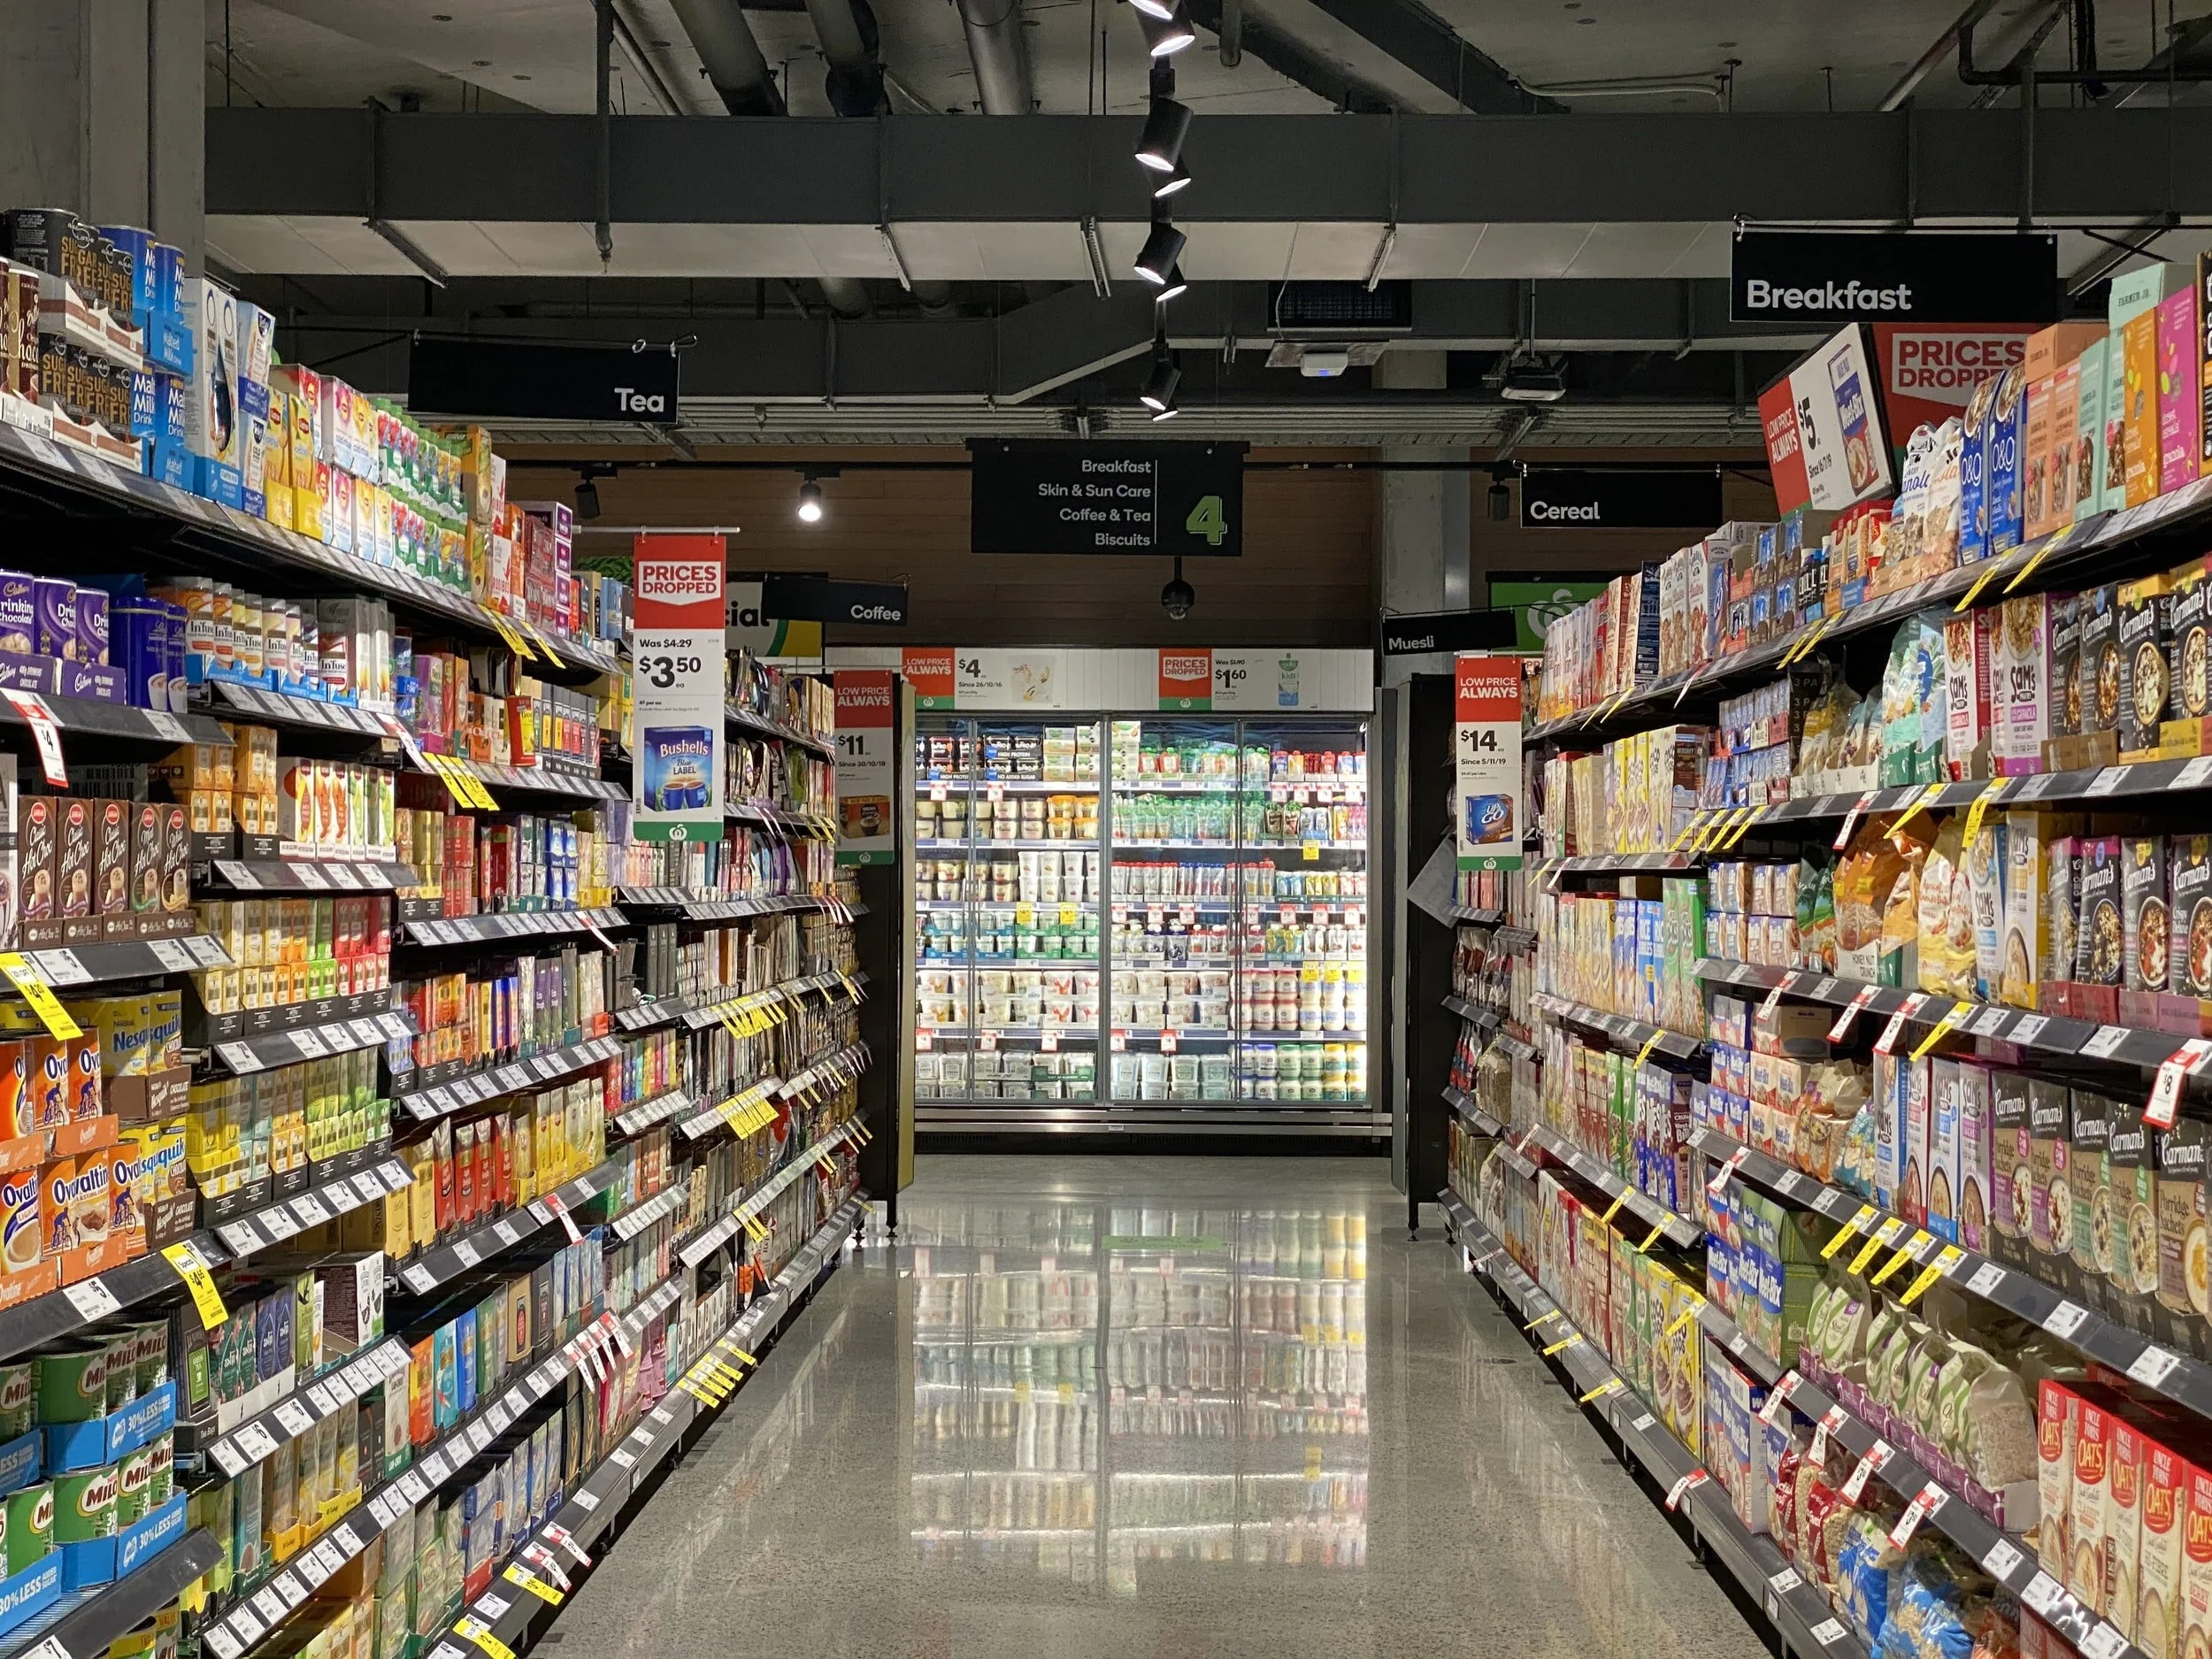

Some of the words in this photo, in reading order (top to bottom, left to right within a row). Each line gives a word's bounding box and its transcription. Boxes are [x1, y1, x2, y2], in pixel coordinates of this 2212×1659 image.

[1747, 280, 1912, 311] Breakfast
[1899, 340, 2025, 366] PRICES
[1898, 368, 2005, 388] DROPP
[614, 388, 664, 412] Tea
[134, 412, 153, 426] Drink
[1778, 408, 1794, 431] PRICE
[1771, 429, 1799, 464] ALWAYS
[1081, 459, 1151, 473] Breakfast
[1038, 483, 1068, 496] Skin
[1071, 484, 1082, 496] &
[1086, 484, 1113, 497] Sun
[1117, 485, 1151, 497] Care
[1059, 508, 1106, 521] Coffee
[1109, 508, 1120, 521] &
[1123, 509, 1151, 521] Tea
[1186, 495, 1227, 545] 4
[1530, 501, 1601, 520] Cereal
[1094, 533, 1151, 546] Biscuits
[642, 565, 717, 581] PRICES
[642, 581, 718, 594] DROPPED
[850, 604, 902, 620] Coffee
[2170, 581, 2205, 629] Carman's
[2082, 604, 2113, 642] Carman's
[2119, 600, 2154, 643] Carman's
[640, 639, 662, 648] Was
[664, 639, 692, 648] $4.29
[1388, 635, 1434, 650] Muesli
[906, 665, 952, 675] ALWAYS
[958, 658, 981, 678] $4
[1164, 658, 1206, 668] PRICES
[74, 672, 92, 693] Cadbury
[838, 687, 859, 695] LOW
[861, 686, 890, 695] PRICE
[1460, 678, 1484, 687] LOW
[1486, 677, 1517, 686] PRICE
[1460, 687, 1518, 699] ALWAYS
[838, 696, 890, 707] ALWAYS
[659, 740, 709, 758] Bushells
[1461, 730, 1497, 751] $14
[673, 766, 696, 775] LABEL
[1481, 809, 1504, 825] GO
[22, 847, 37, 879] Hot
[61, 849, 74, 877] Hot
[99, 847, 112, 876] Hot
[134, 849, 147, 876] Hot
[164, 849, 177, 876] Hot
[2124, 857, 2156, 893] Carman's
[2173, 856, 2211, 892] Carman's
[170, 1082, 188, 1094] CHOCOLATE
[2163, 1073, 2173, 1096] $8
[1994, 1087, 2025, 1117] Carman's
[2031, 1097, 2063, 1126] Carman's
[2108, 1121, 2145, 1153] Carman's
[176, 1202, 194, 1217] CHOCOLATE
[2159, 1188, 2191, 1219] Porridge
[2046, 1387, 2059, 1407] UNCLE
[142, 1400, 158, 1420] LESS
[2045, 1402, 2058, 1420] TOBYS
[2084, 1407, 2101, 1428] UNCLE
[2040, 1417, 2061, 1448] OATS
[2084, 1420, 2101, 1442] TOBYS
[2116, 1425, 2131, 1447] UNCLE
[2078, 1438, 2104, 1471] OATS
[2116, 1441, 2131, 1463] TOBYS
[2153, 1448, 2172, 1471] UNCLE
[2113, 1458, 2136, 1493] OATS
[2152, 1463, 2170, 1486] TOBYS
[2146, 1482, 2173, 1516] OATS
[139, 1529, 155, 1550] 30%
[154, 1516, 172, 1540] LESS
[20, 1574, 42, 1600] LESS
